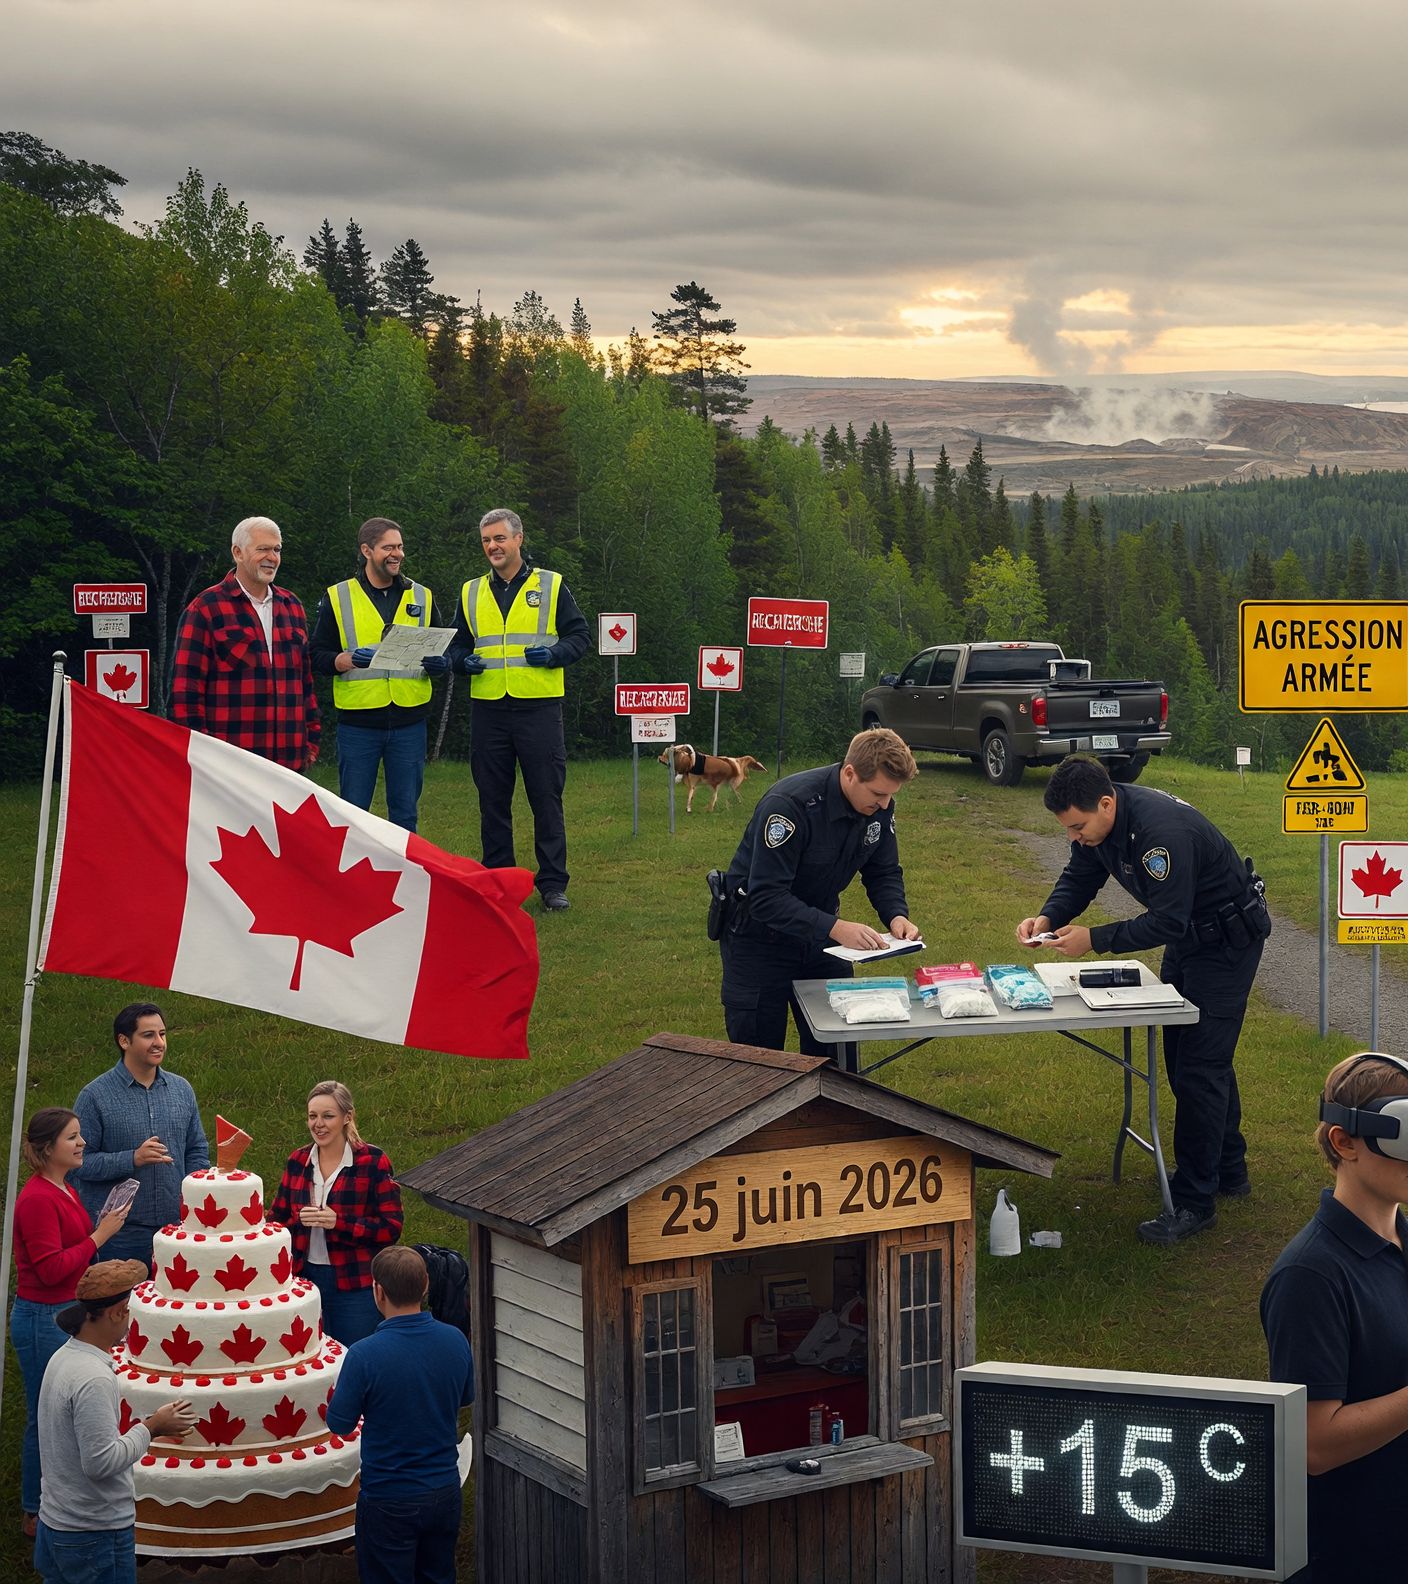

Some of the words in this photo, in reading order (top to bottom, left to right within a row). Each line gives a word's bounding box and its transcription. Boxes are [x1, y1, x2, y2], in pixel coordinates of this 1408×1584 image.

[1253, 619, 1403, 650] AGRESSION
[1282, 654, 1372, 692] ARMÉE
[661, 1180, 719, 1237] 25
[732, 1170, 822, 1243] juin
[839, 1155, 943, 1215] 2026
